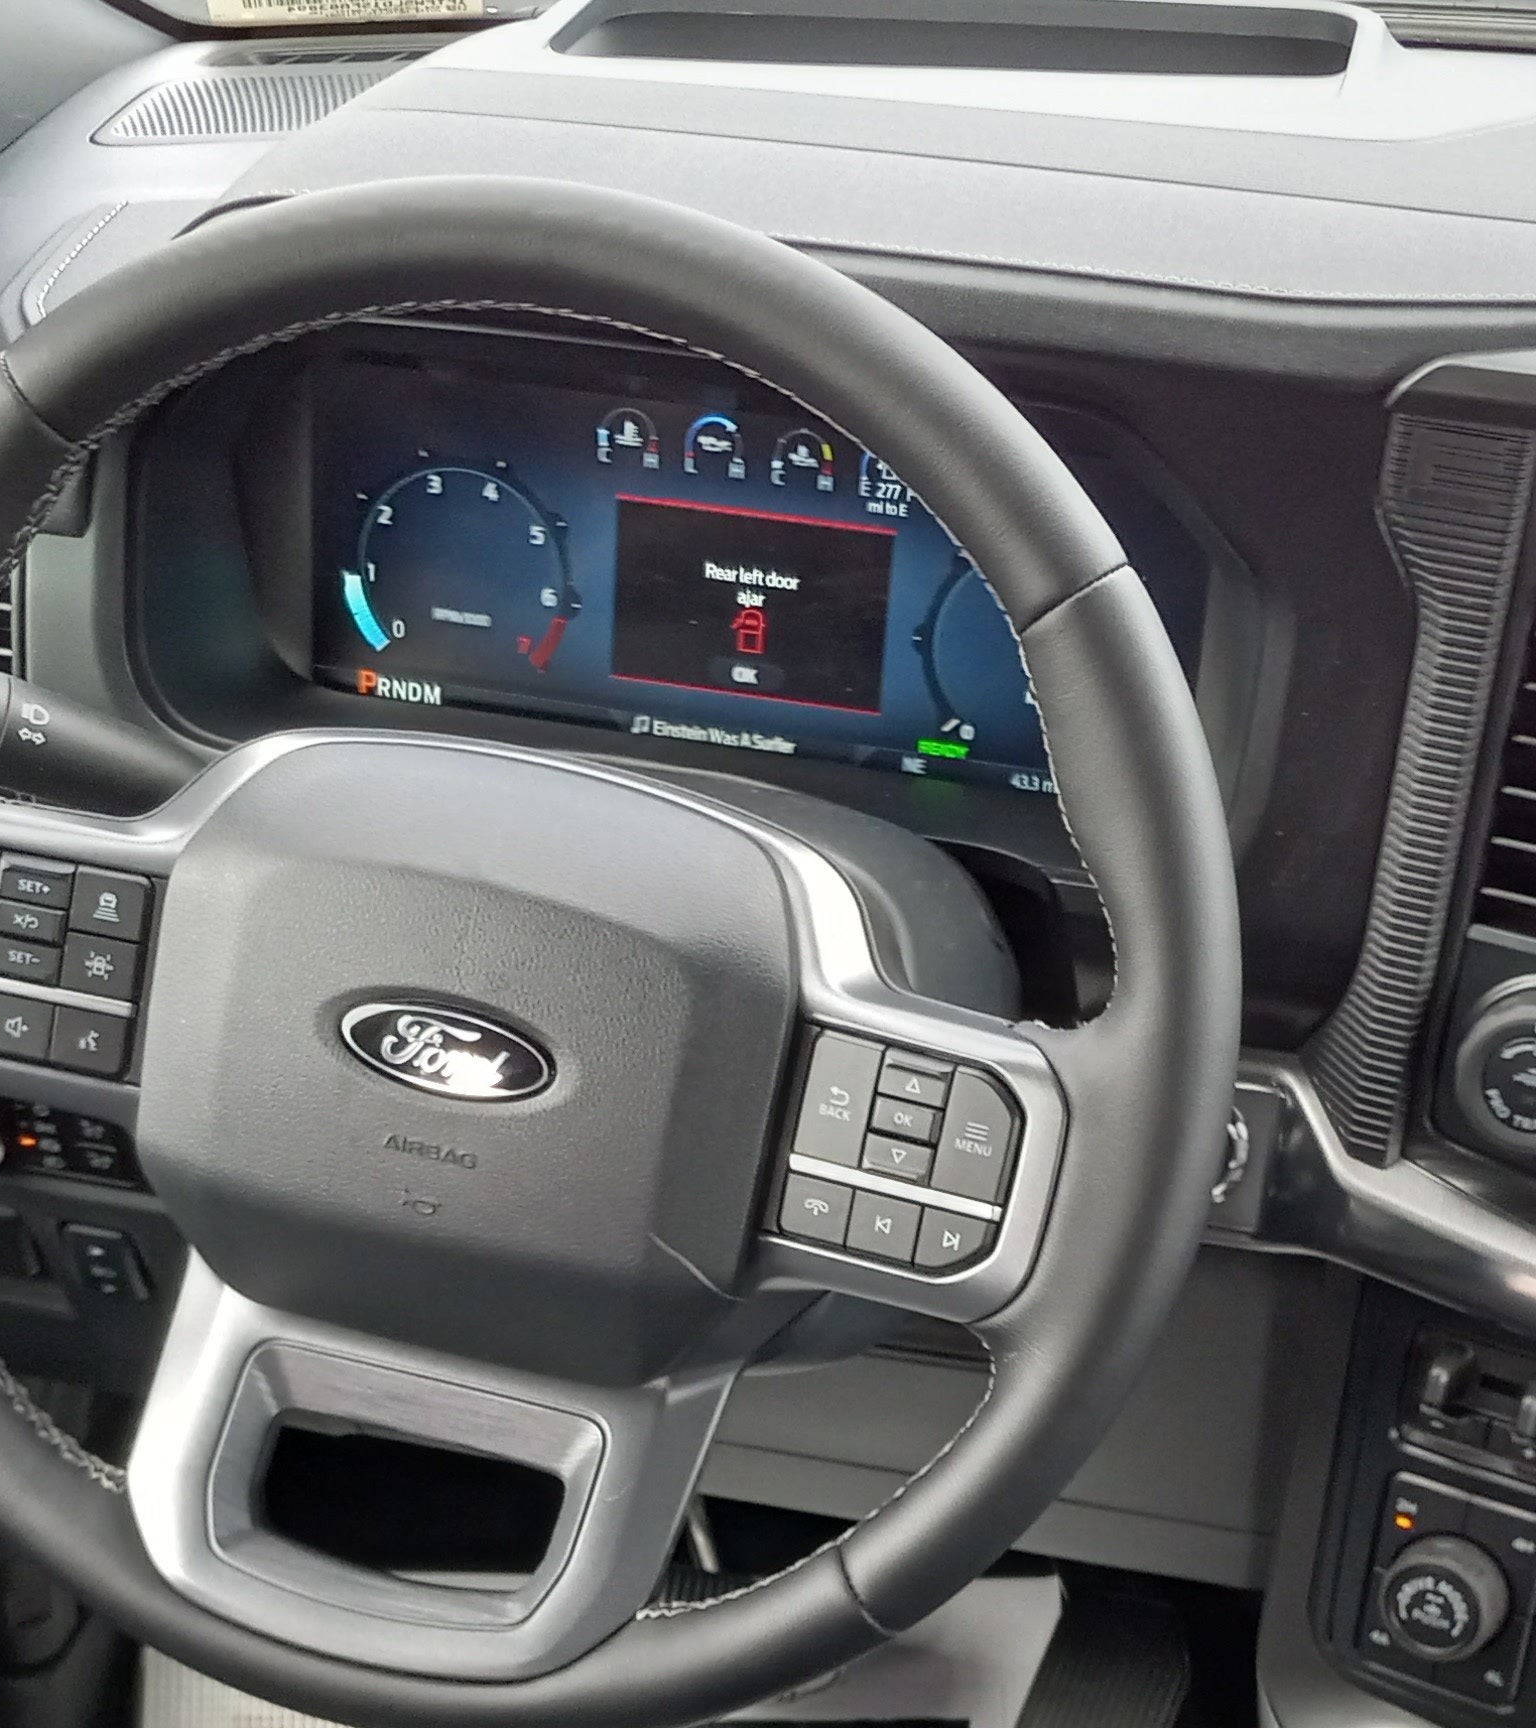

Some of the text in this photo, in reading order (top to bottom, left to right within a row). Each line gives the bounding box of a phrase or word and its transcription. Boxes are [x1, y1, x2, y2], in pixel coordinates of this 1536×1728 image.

[426, 474, 444, 494] 3
[482, 482, 500, 501] 4
[875, 482, 902, 500] 277
[376, 505, 394, 525] 2
[528, 525, 547, 545] 5
[367, 561, 376, 582] 1
[704, 561, 800, 590] Rear left door
[540, 587, 558, 607] 6
[736, 590, 766, 608] ajar
[392, 619, 406, 639] 0
[731, 666, 759, 685] OK
[358, 668, 442, 705] PRNDM
[652, 719, 707, 741] Einstein
[708, 728, 739, 747] Was
[1010, 773, 1040, 792] 43.3
[819, 1103, 851, 1122] BACK
[893, 1112, 914, 1127] OK
[955, 1138, 992, 1157] MENU
